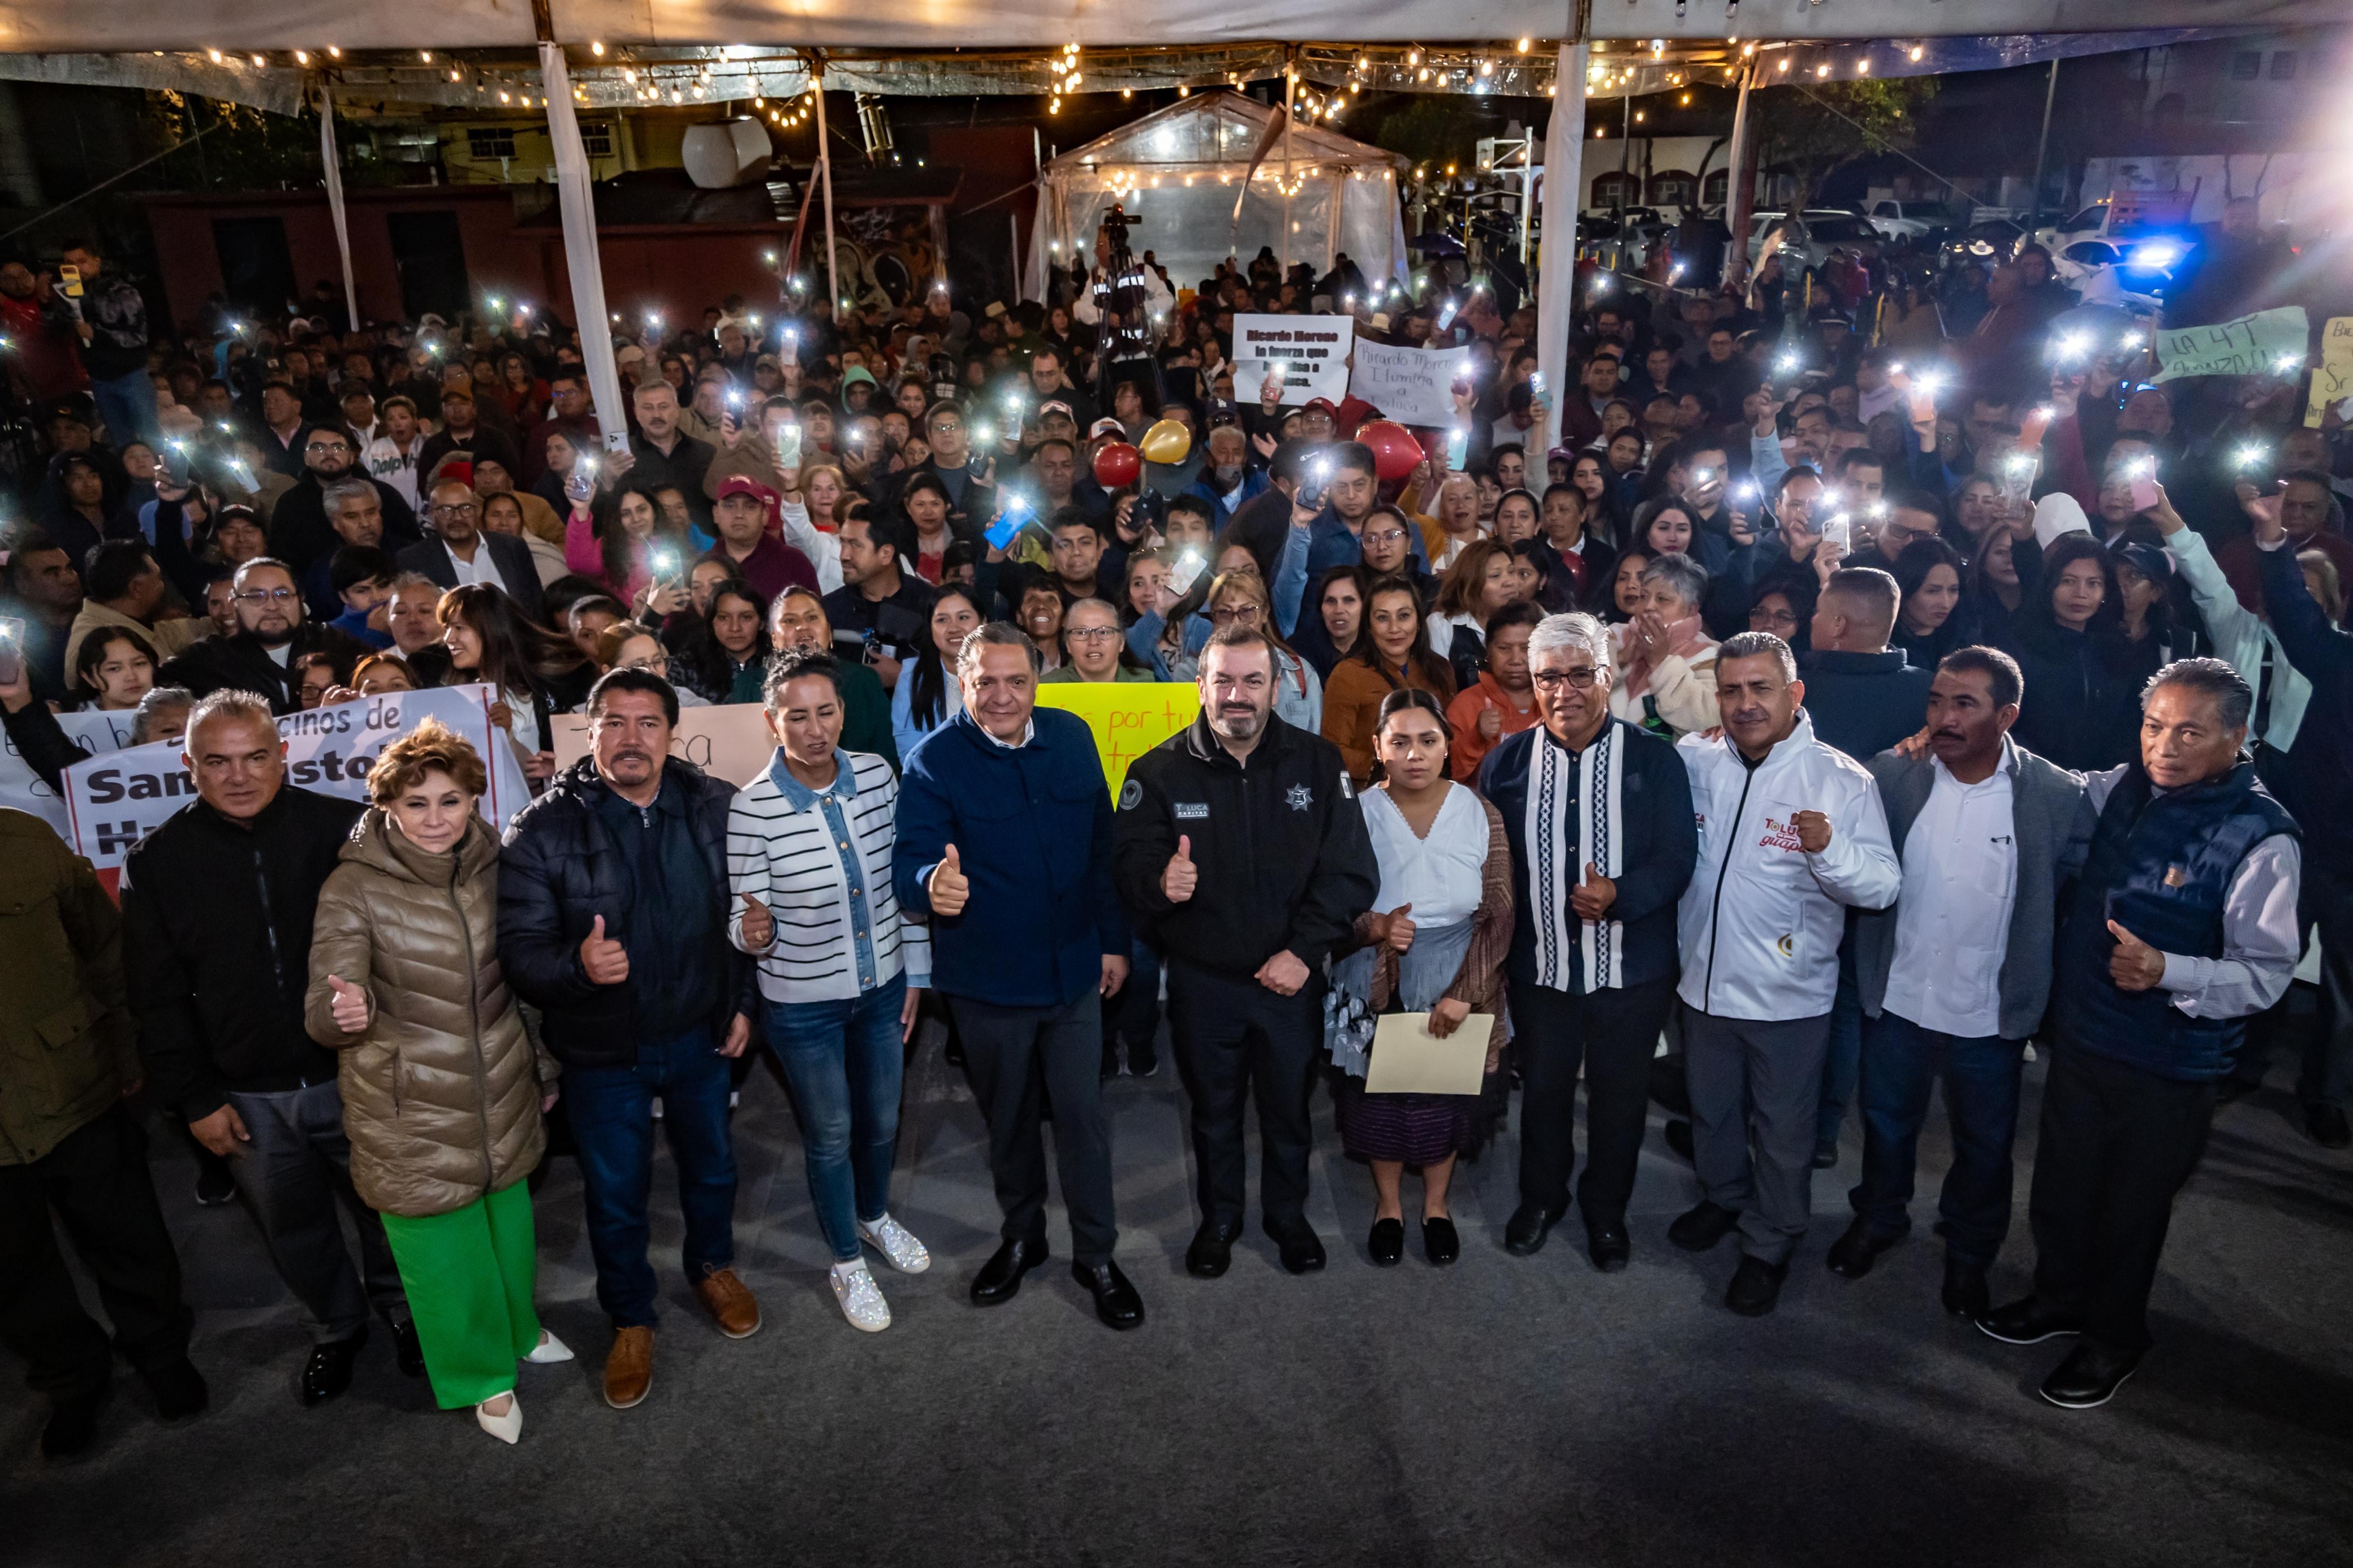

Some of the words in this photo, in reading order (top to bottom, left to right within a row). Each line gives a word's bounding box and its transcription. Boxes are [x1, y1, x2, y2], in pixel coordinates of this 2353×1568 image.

[1247, 330, 1292, 342] Ricardo
[1294, 331, 1338, 342] Moreno
[2171, 335, 2199, 355] LA
[2209, 314, 2257, 349] 4T
[1255, 345, 1266, 357] la
[1269, 345, 1304, 358] fuerza
[1307, 348, 1329, 359] que
[1358, 343, 1408, 366] Ricardo
[1312, 363, 1320, 373] a
[1397, 388, 1406, 396] a
[277, 710, 350, 737] cinos
[367, 698, 400, 730] de
[1108, 711, 1153, 742] por
[87, 768, 198, 804] San
[1175, 804, 1208, 812] TLUCA
